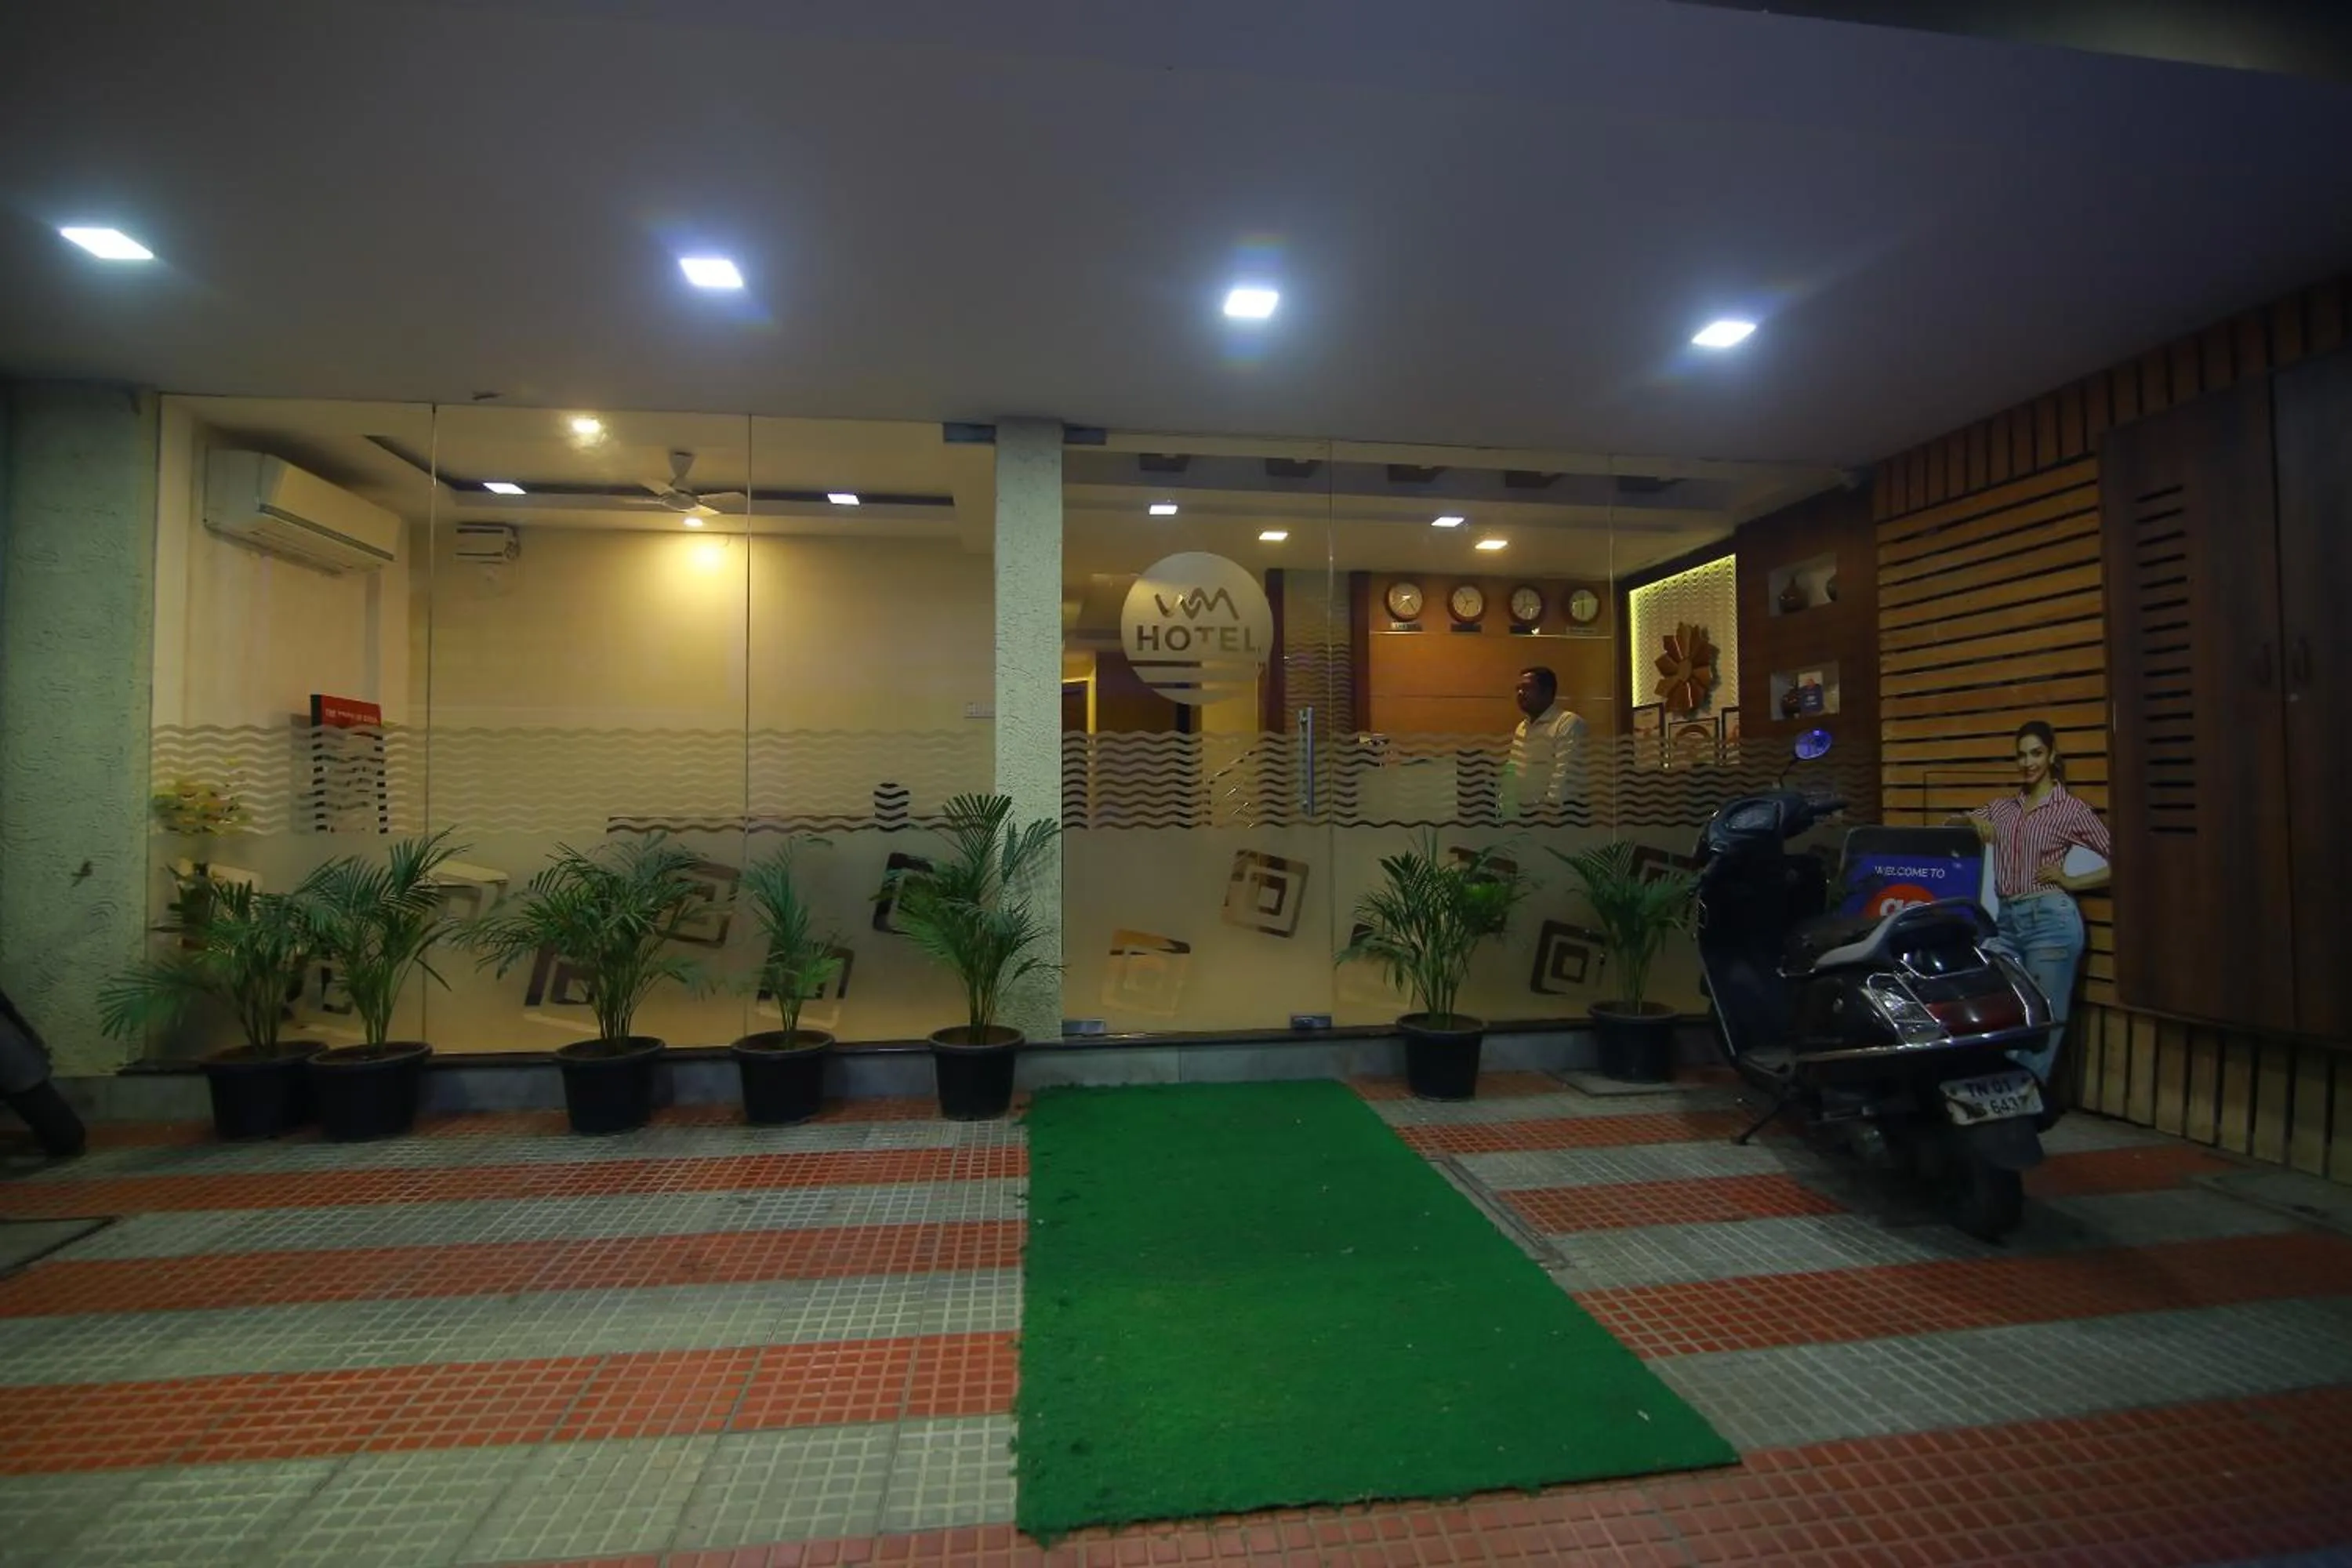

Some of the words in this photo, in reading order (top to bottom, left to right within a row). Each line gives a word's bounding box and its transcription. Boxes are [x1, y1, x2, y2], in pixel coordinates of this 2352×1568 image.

[1136, 625, 1258, 652] HOTEL
[1875, 865, 1928, 877] WELCOME
[1930, 867, 1945, 879] TO
